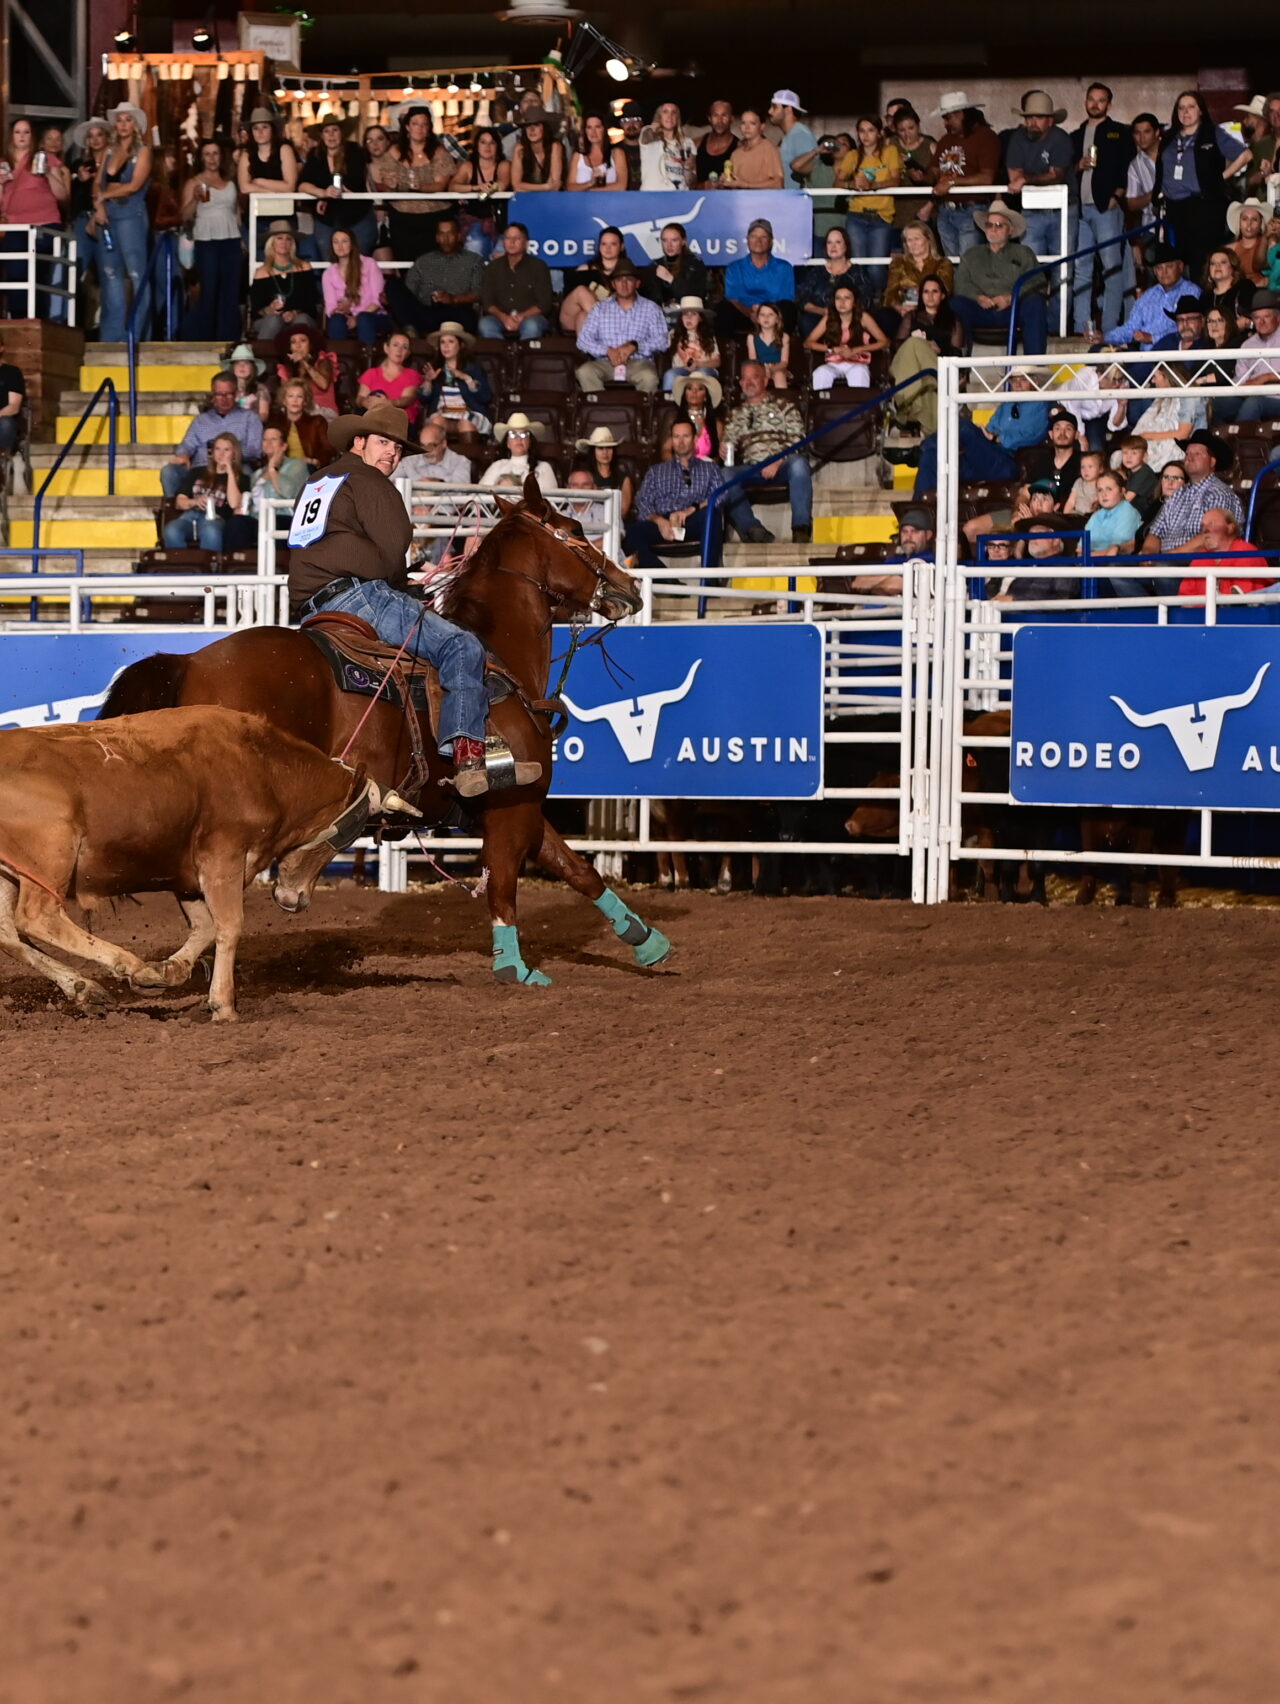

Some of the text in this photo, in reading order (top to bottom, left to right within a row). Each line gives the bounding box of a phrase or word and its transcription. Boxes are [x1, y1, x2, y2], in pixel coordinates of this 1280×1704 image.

[526, 238, 787, 255] RODE AUSN
[301, 498, 321, 526] 19
[677, 737, 808, 762] AUSTIN
[1016, 741, 1141, 769] RODEO
